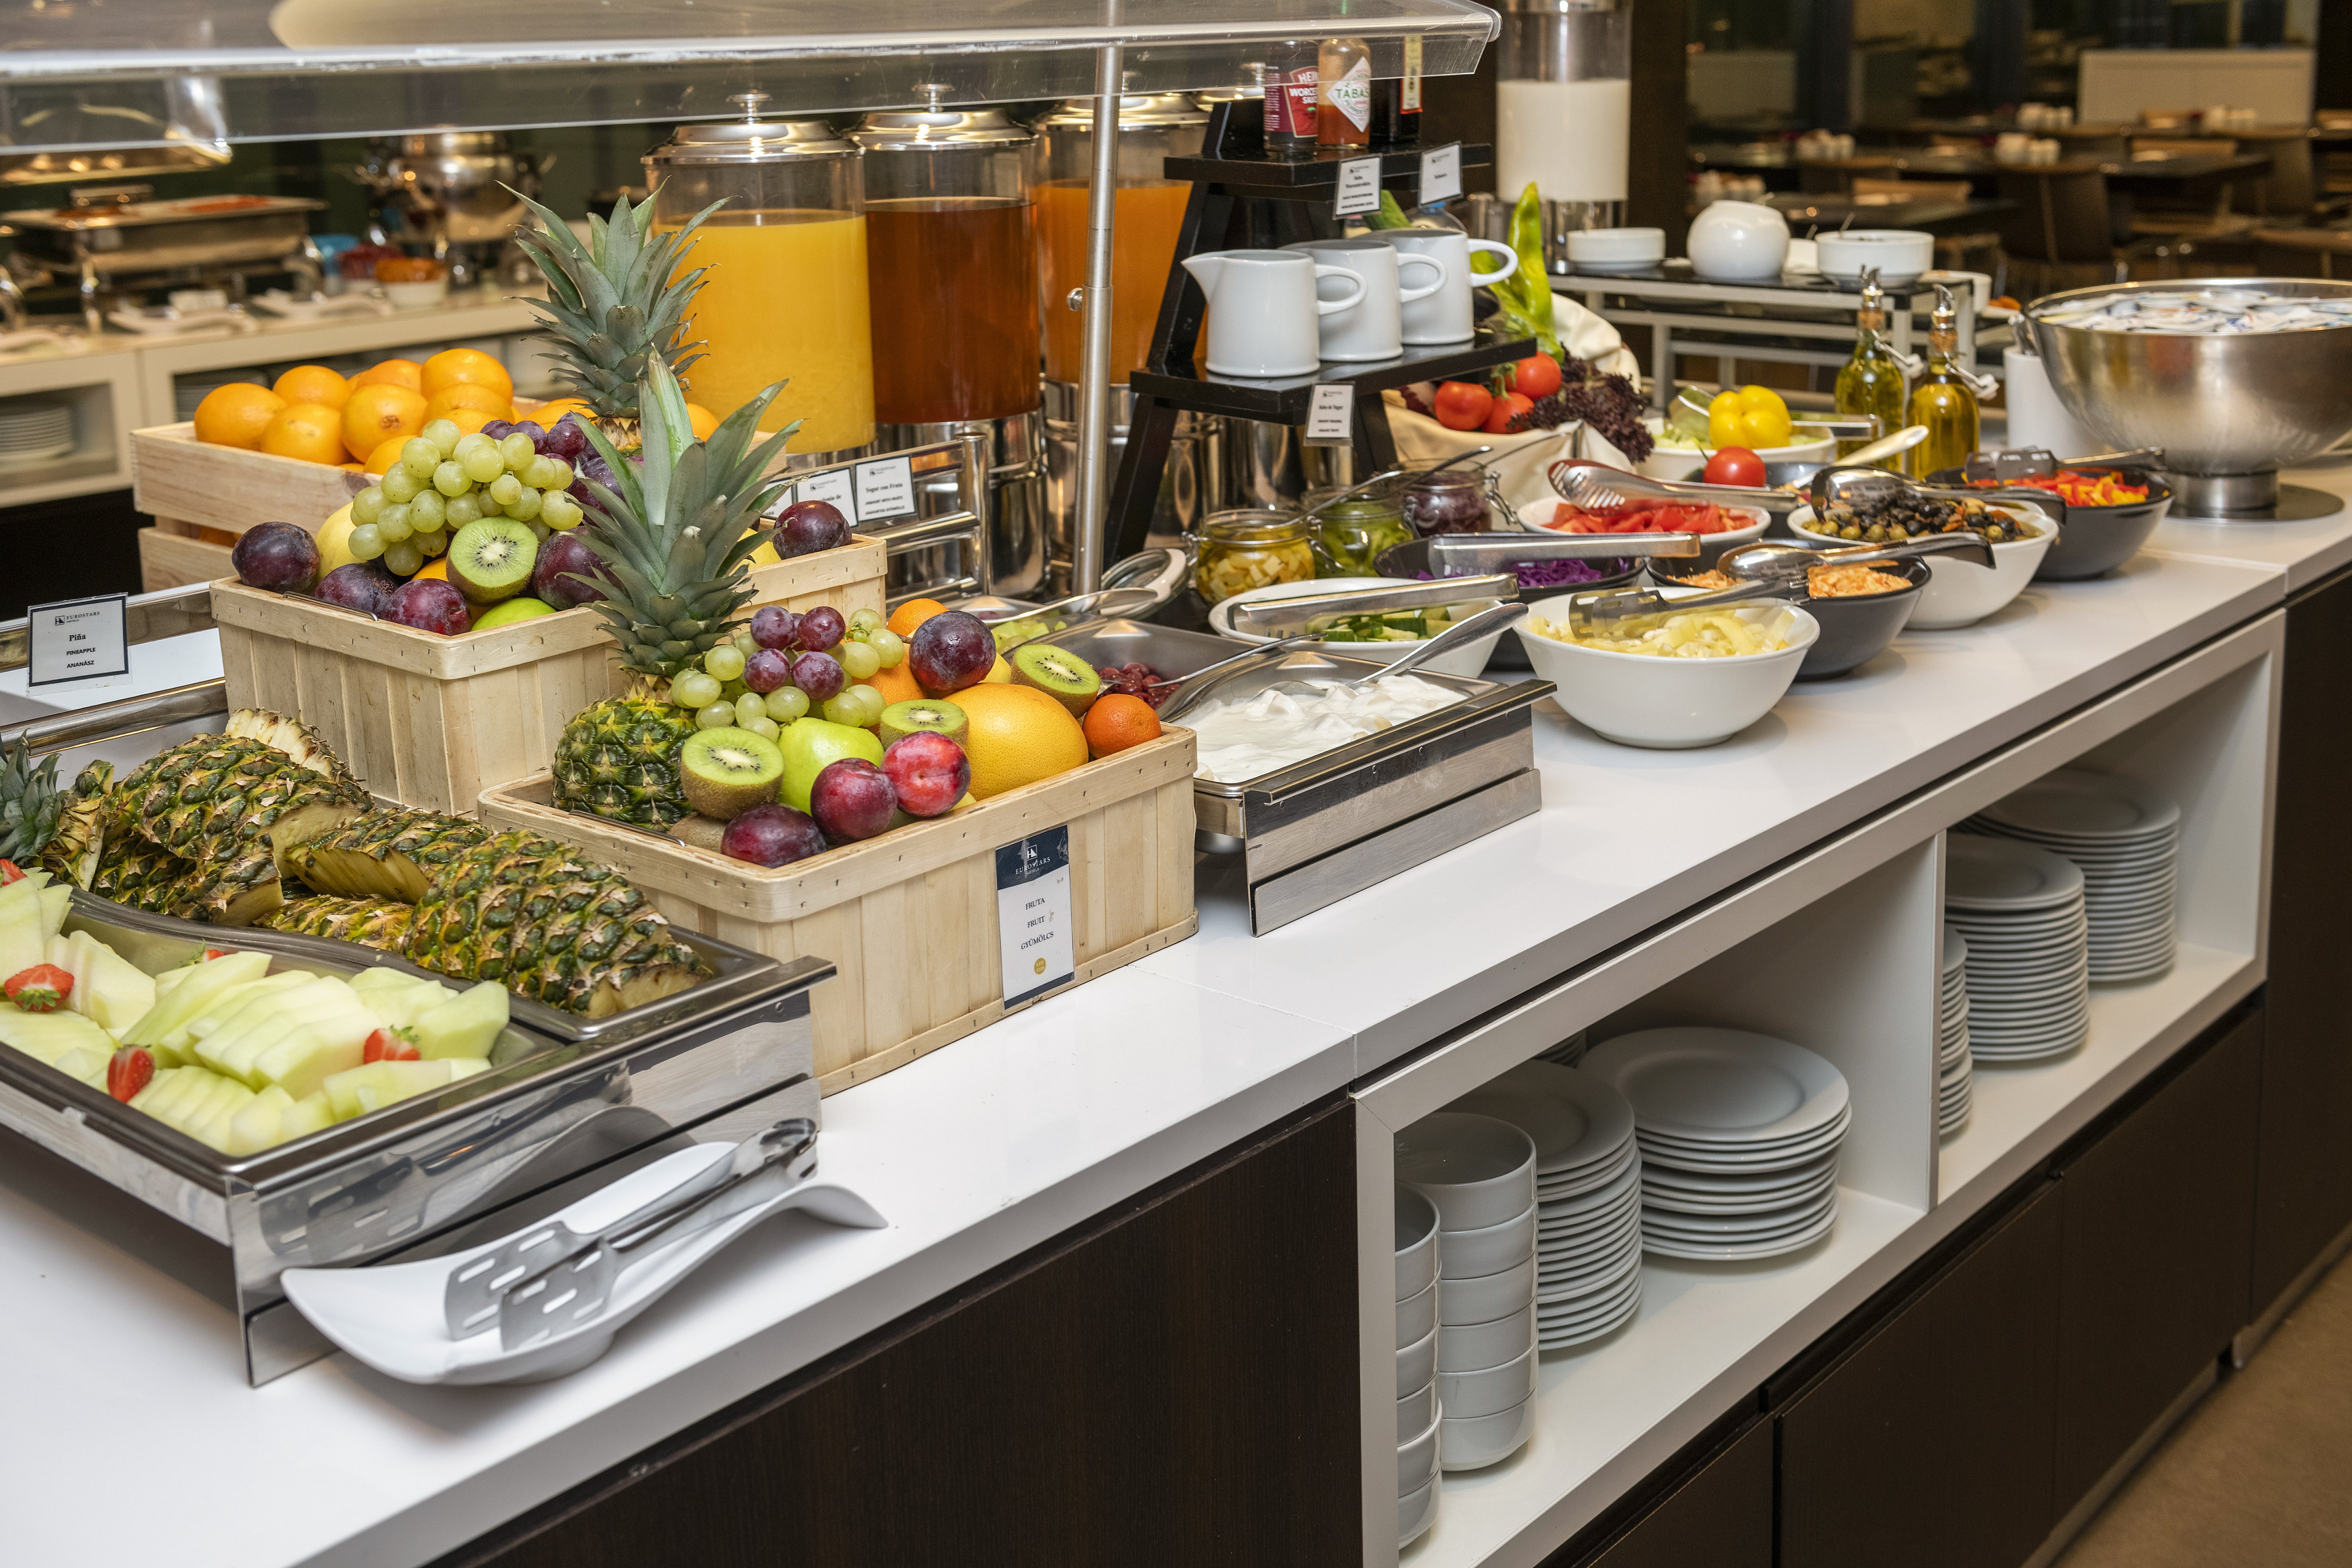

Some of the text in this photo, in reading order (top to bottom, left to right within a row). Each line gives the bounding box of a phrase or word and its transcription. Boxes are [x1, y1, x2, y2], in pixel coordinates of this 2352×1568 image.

[1335, 88, 1369, 98] TABAS
[66, 611, 100, 620] EUROSTARS
[67, 660, 94, 669] ANANÁSZ
[1016, 857, 1050, 874] EUROSTARS
[1026, 898, 1045, 910] FRUTA
[1027, 915, 1045, 928] FRUIT
[1021, 931, 1054, 950] GYÜMÖLCS
